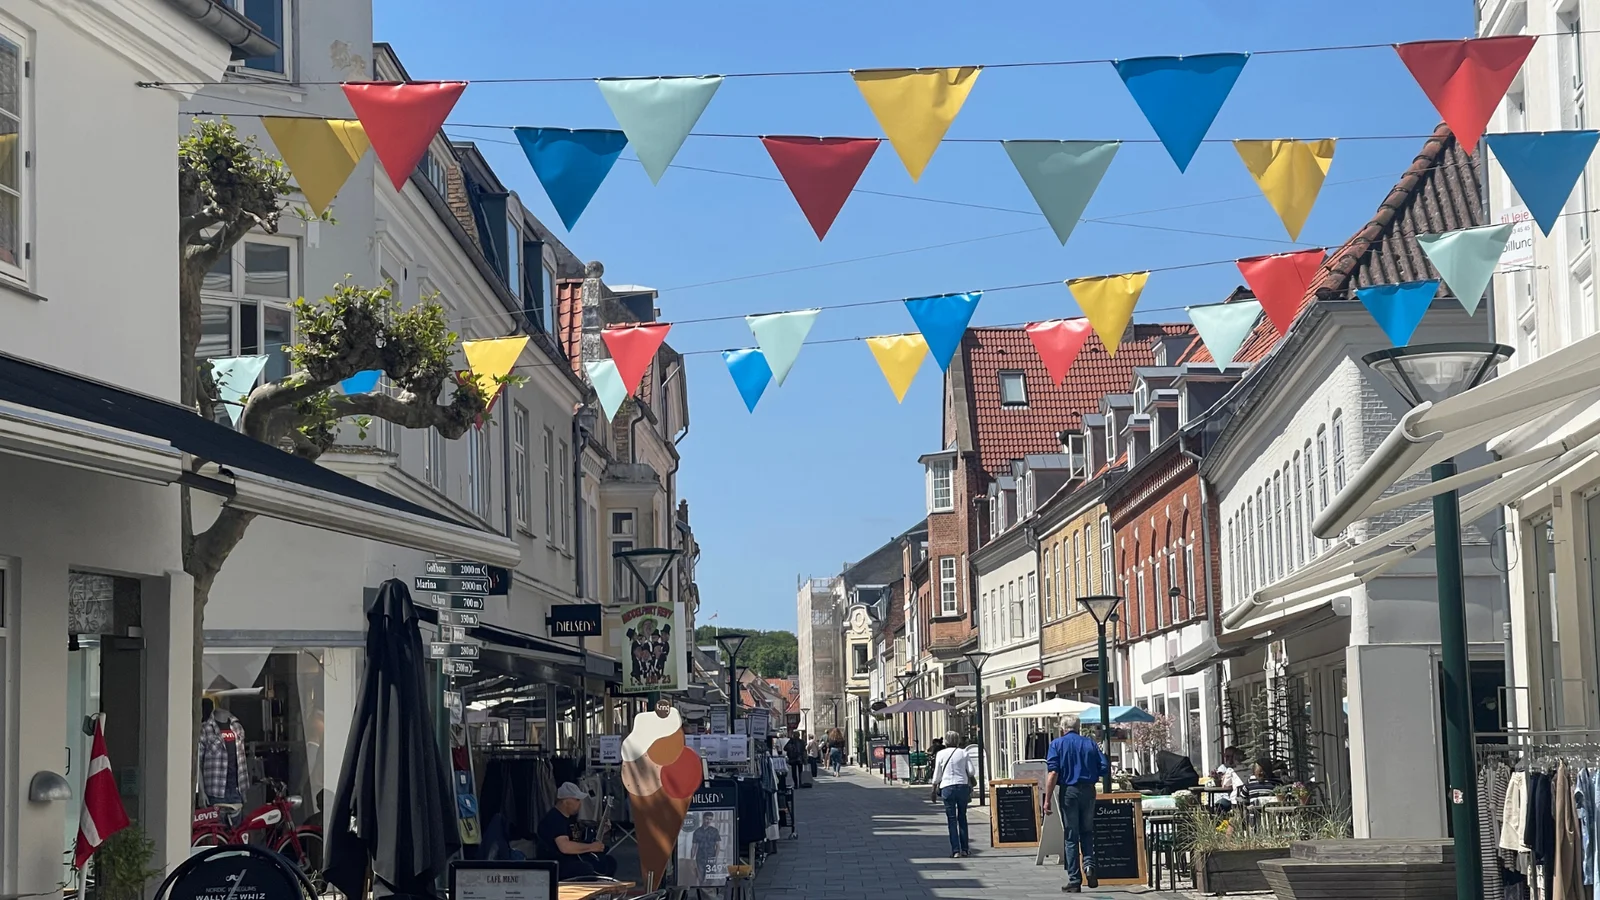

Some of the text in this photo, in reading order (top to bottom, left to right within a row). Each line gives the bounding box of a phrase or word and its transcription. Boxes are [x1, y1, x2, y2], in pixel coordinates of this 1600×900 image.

[1501, 210, 1529, 224] til leje
[416, 578, 437, 589] Marina
[503, 875, 519, 883] MENU
[239, 892, 266, 900] WHIZ
